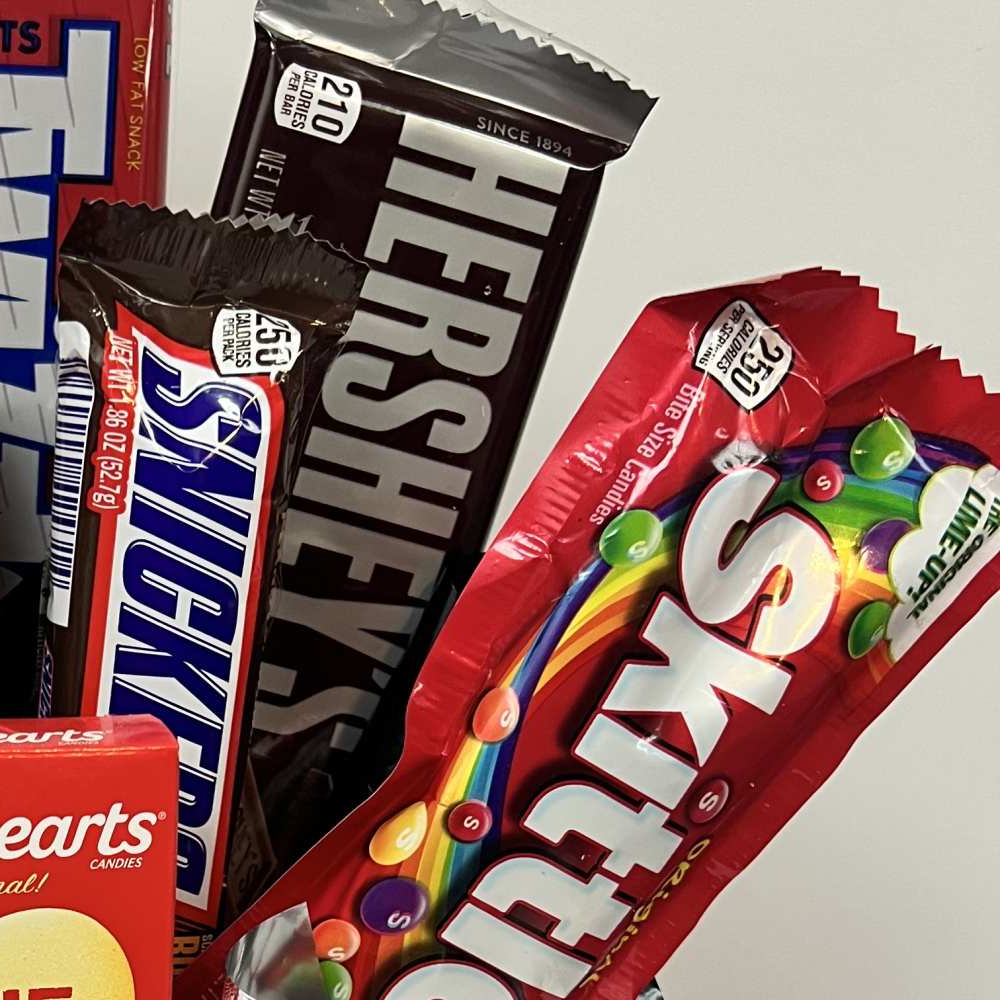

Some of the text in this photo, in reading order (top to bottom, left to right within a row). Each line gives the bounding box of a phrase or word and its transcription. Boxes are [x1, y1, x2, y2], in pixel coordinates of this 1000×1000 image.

[128, 79, 146, 114] FAT
[280, 71, 301, 116] PER BAR
[291, 70, 318, 130] CALORIES
[312, 76, 353, 137] 210
[126, 115, 144, 172] SNACK
[476, 116, 573, 158] SINCE 1894
[253, 148, 287, 187] NET
[108, 335, 134, 365] NET
[222, 317, 235, 363] PER PACK
[235, 312, 251, 369] CALORIES
[698, 303, 747, 367] PER SERNG
[716, 319, 756, 375] CALORIES
[107, 366, 132, 390] WT
[730, 332, 785, 398] 250
[102, 432, 126, 452] OZ
[637, 421, 678, 459] Size
[92, 455, 124, 511] (52.7g)
[589, 458, 651, 526] Candies
[89, 855, 143, 870] CANDIES
